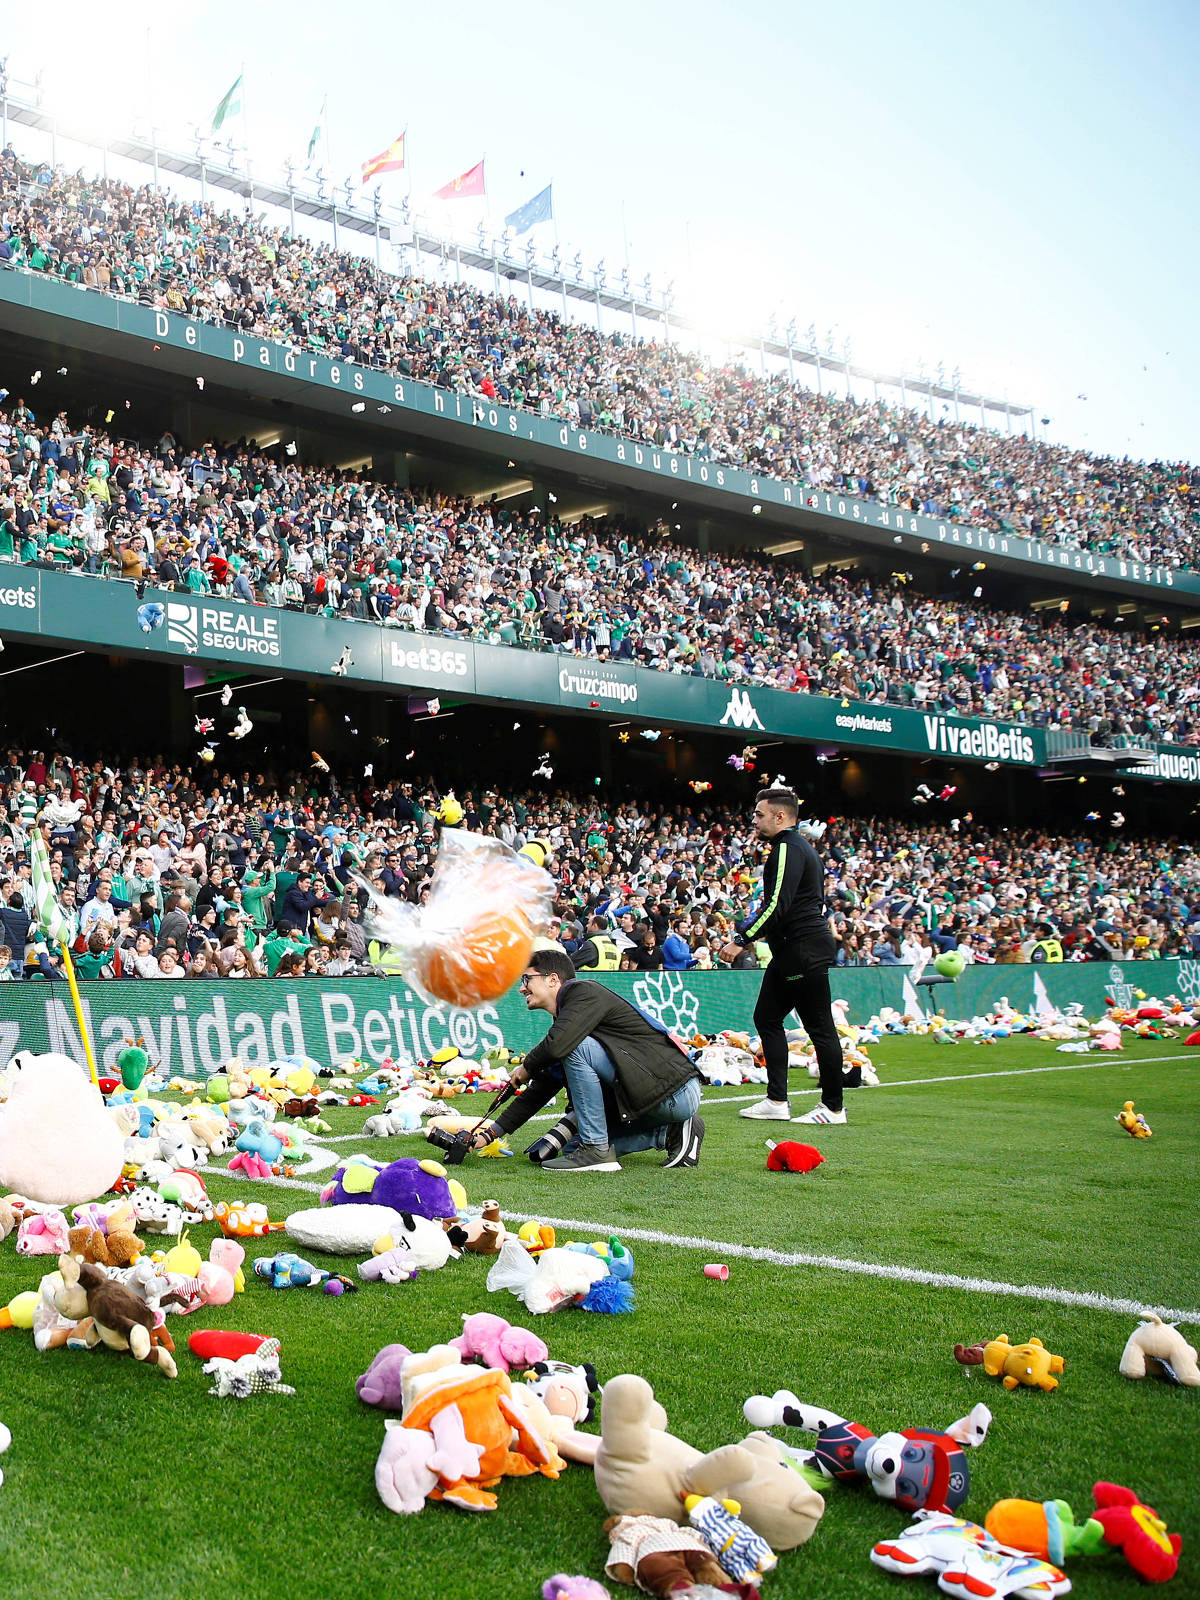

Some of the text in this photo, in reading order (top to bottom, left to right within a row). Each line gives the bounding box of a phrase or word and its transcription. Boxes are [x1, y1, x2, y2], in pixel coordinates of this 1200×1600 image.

[156, 313, 1174, 586] De padres a hijos, de abuelos a nietos, una pasión llamada BETIS
[202, 608, 278, 640] REALE
[202, 631, 280, 657] SEGUROS
[391, 641, 468, 676] bet365
[559, 668, 638, 704] Cruzcampo
[835, 714, 893, 733] easyMarkets
[923, 715, 1035, 763] VivaelBetis
[46, 994, 307, 1083] Navidad
[321, 991, 504, 1068] Betic@s
